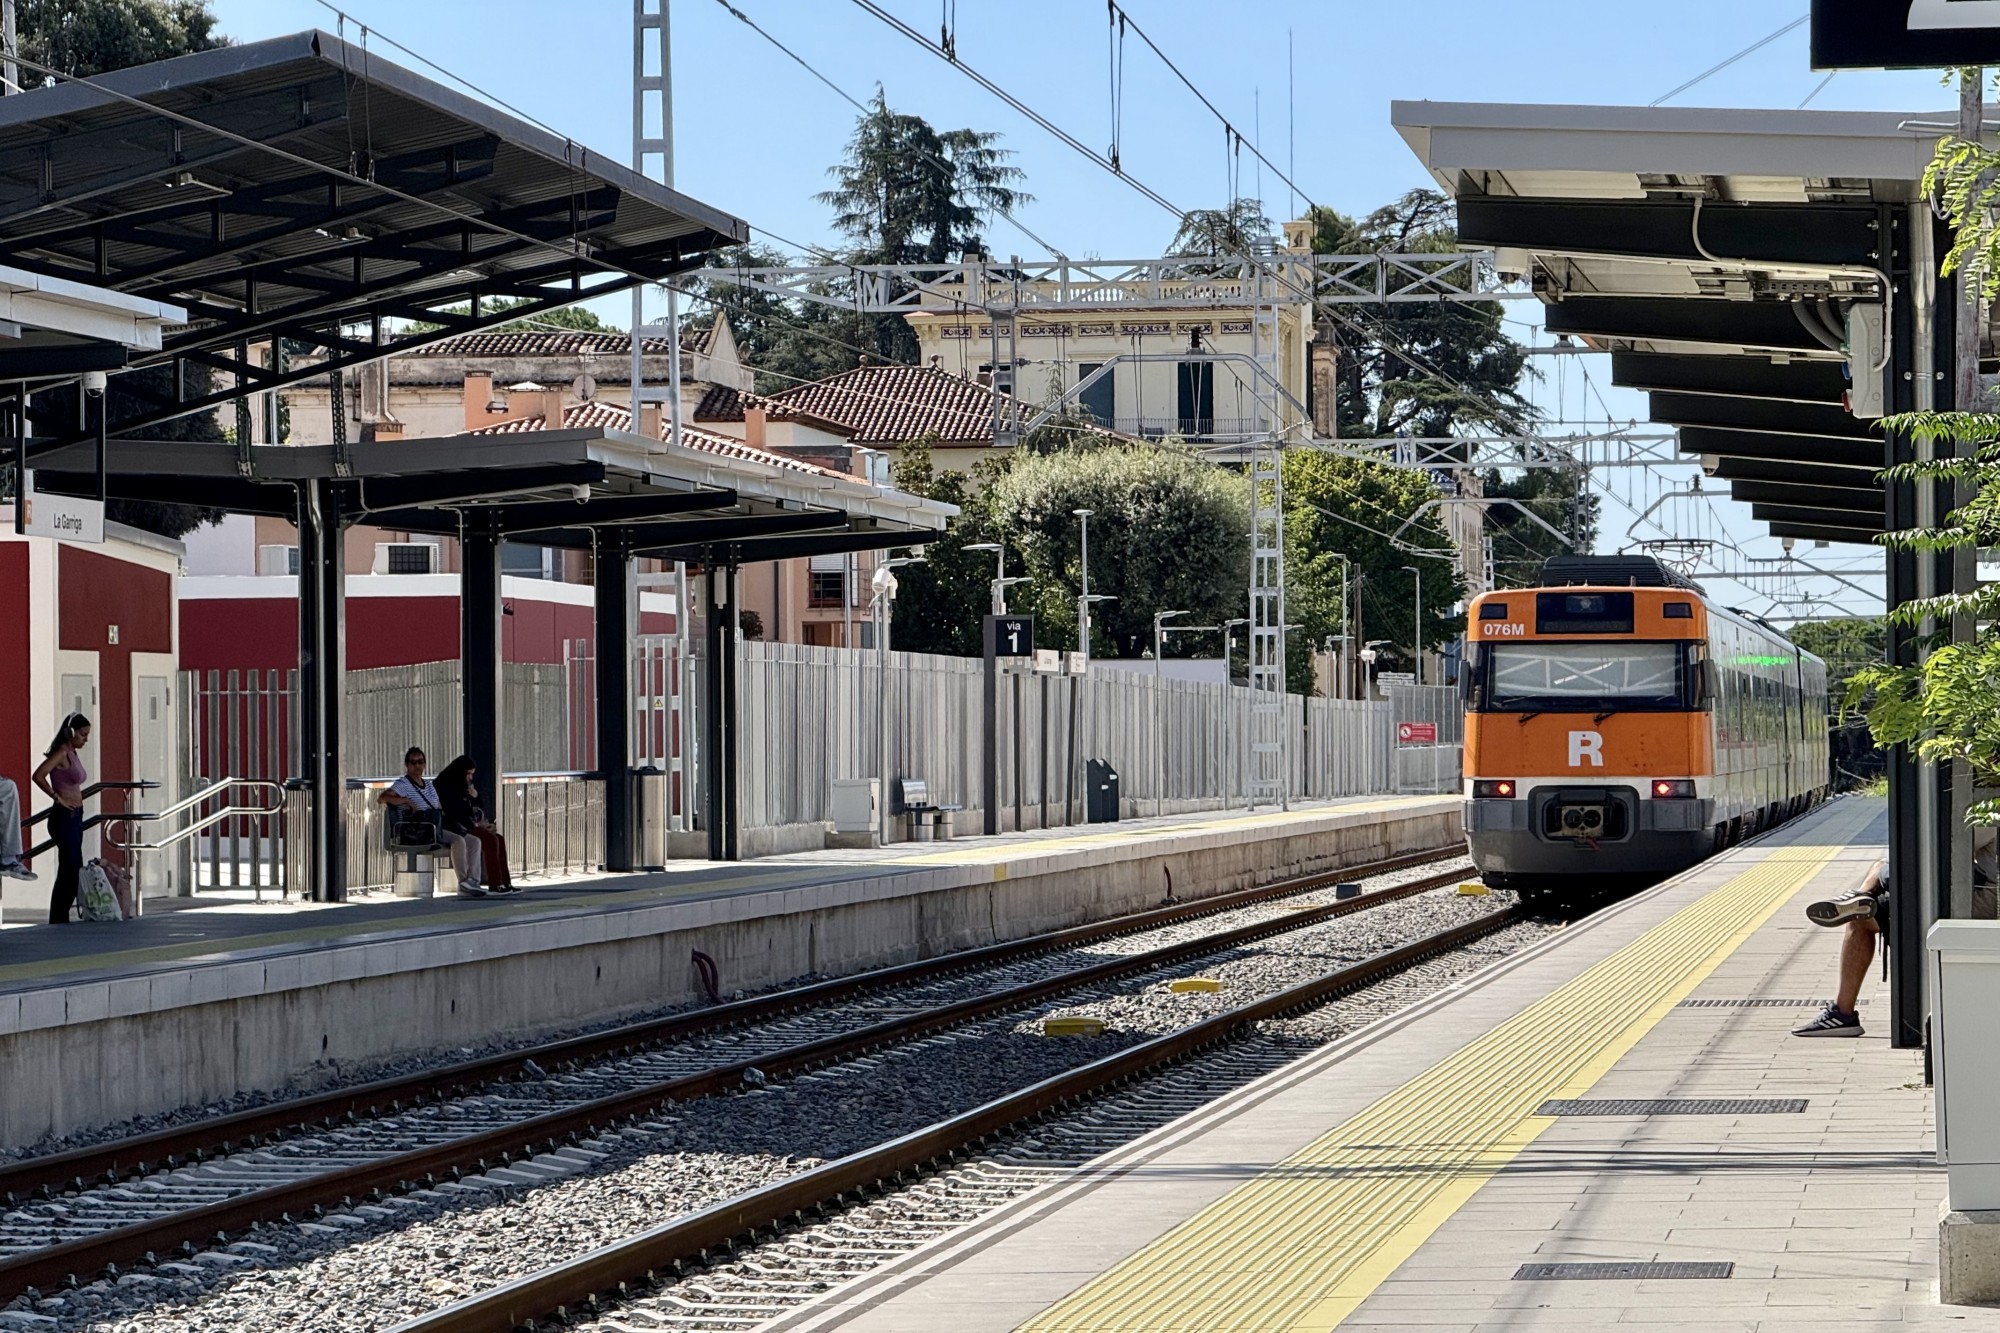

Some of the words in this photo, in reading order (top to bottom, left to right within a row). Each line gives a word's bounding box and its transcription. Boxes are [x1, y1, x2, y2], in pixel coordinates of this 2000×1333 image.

[53, 513, 60, 529] La
[62, 513, 82, 534] Garriga
[1006, 621, 1021, 631] via
[1483, 623, 1525, 636] 076M
[1008, 632, 1018, 653] 1
[1568, 730, 1604, 767] R
